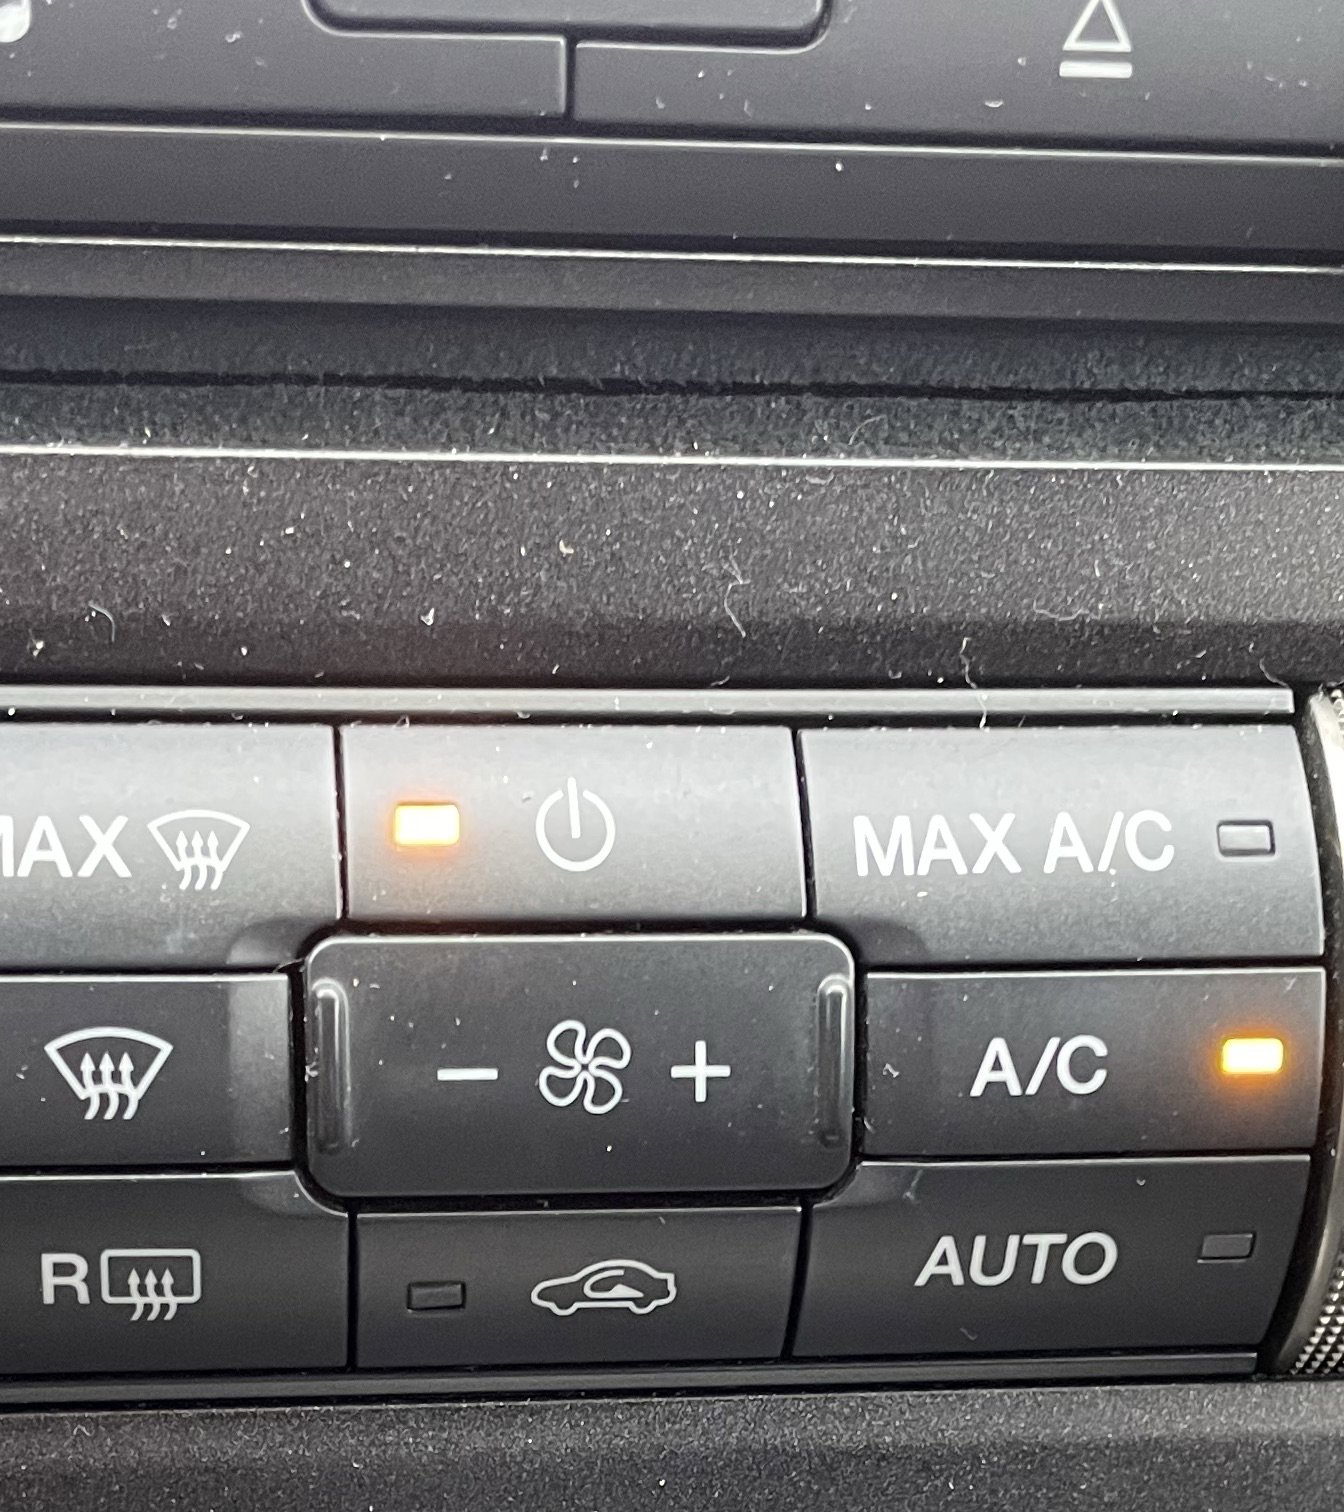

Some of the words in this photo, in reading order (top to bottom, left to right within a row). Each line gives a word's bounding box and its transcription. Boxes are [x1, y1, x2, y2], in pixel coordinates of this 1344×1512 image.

[852, 811, 1018, 877] MAX
[1043, 809, 1175, 874] A/C
[969, 1034, 1108, 1097] A/C
[41, 1252, 90, 1305] R
[914, 1231, 1118, 1287] AUTO
